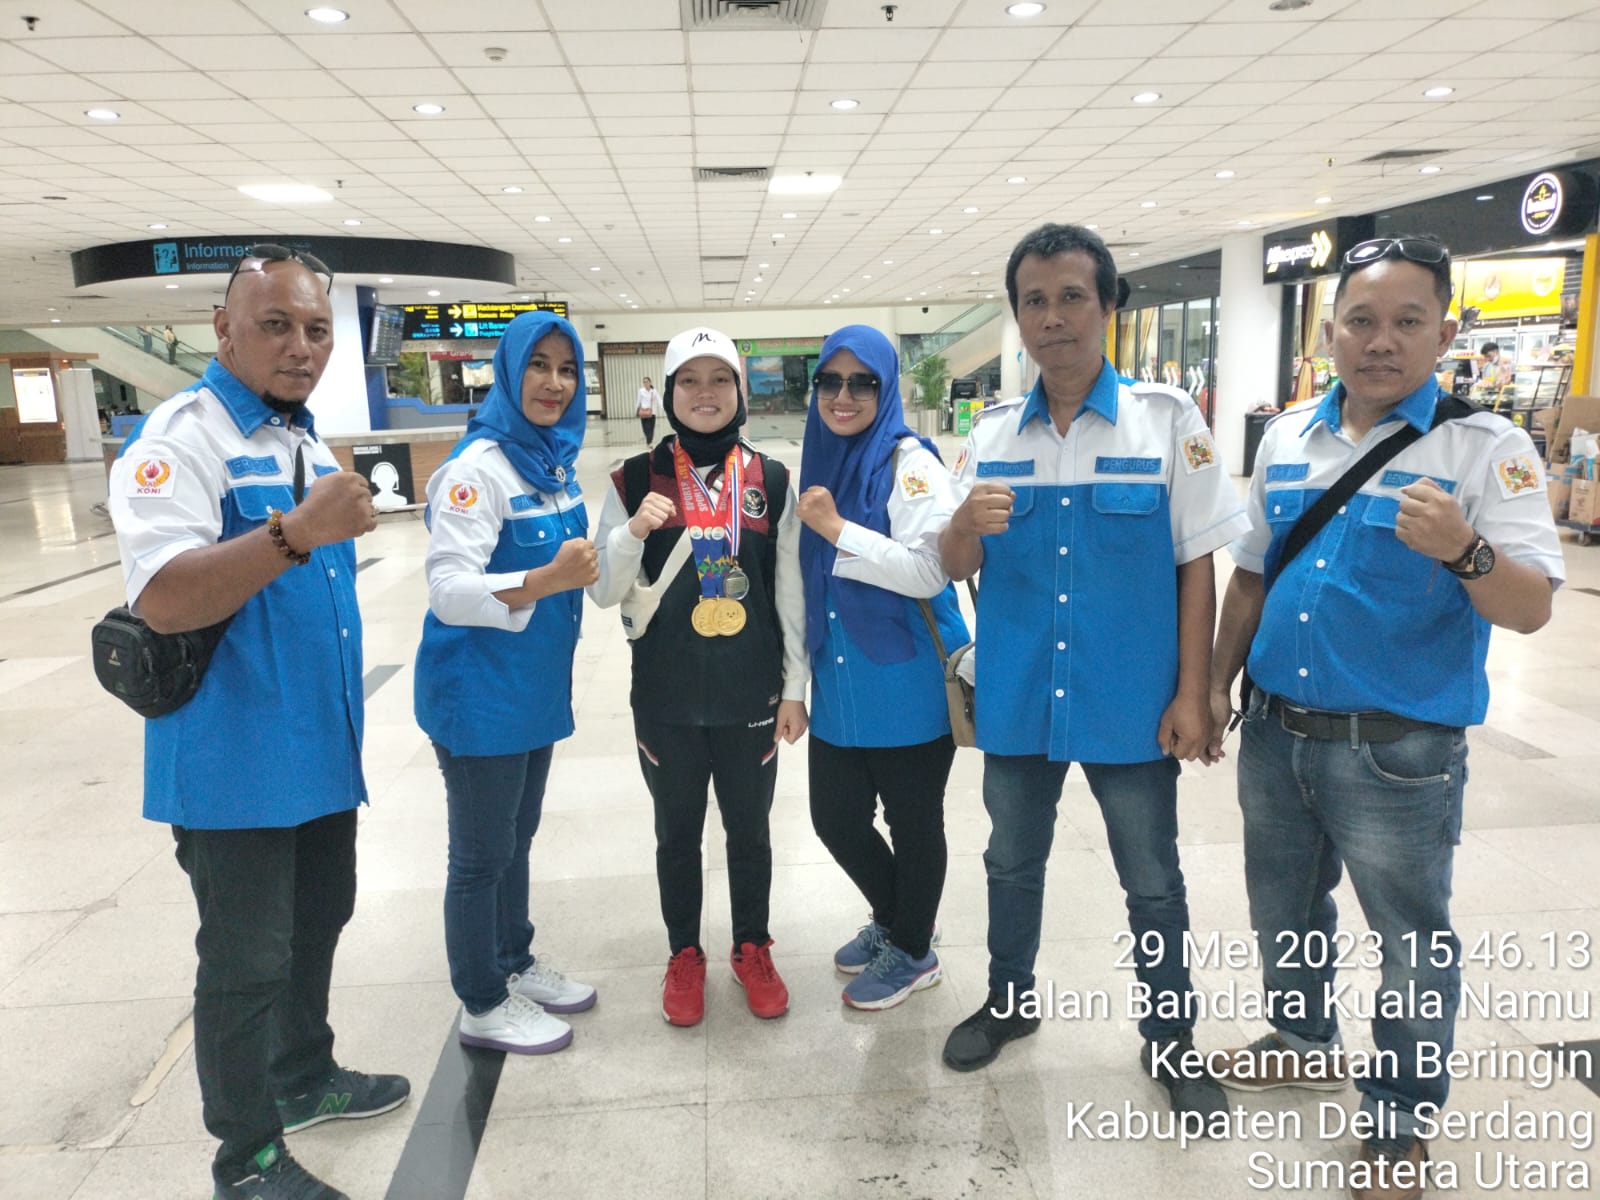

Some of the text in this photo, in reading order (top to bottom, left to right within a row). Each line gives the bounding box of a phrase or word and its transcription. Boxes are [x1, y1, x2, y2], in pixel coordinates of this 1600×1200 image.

[184, 243, 253, 258] Informas
[186, 262, 229, 270] Information
[1103, 459, 1157, 471] PENGURUS
